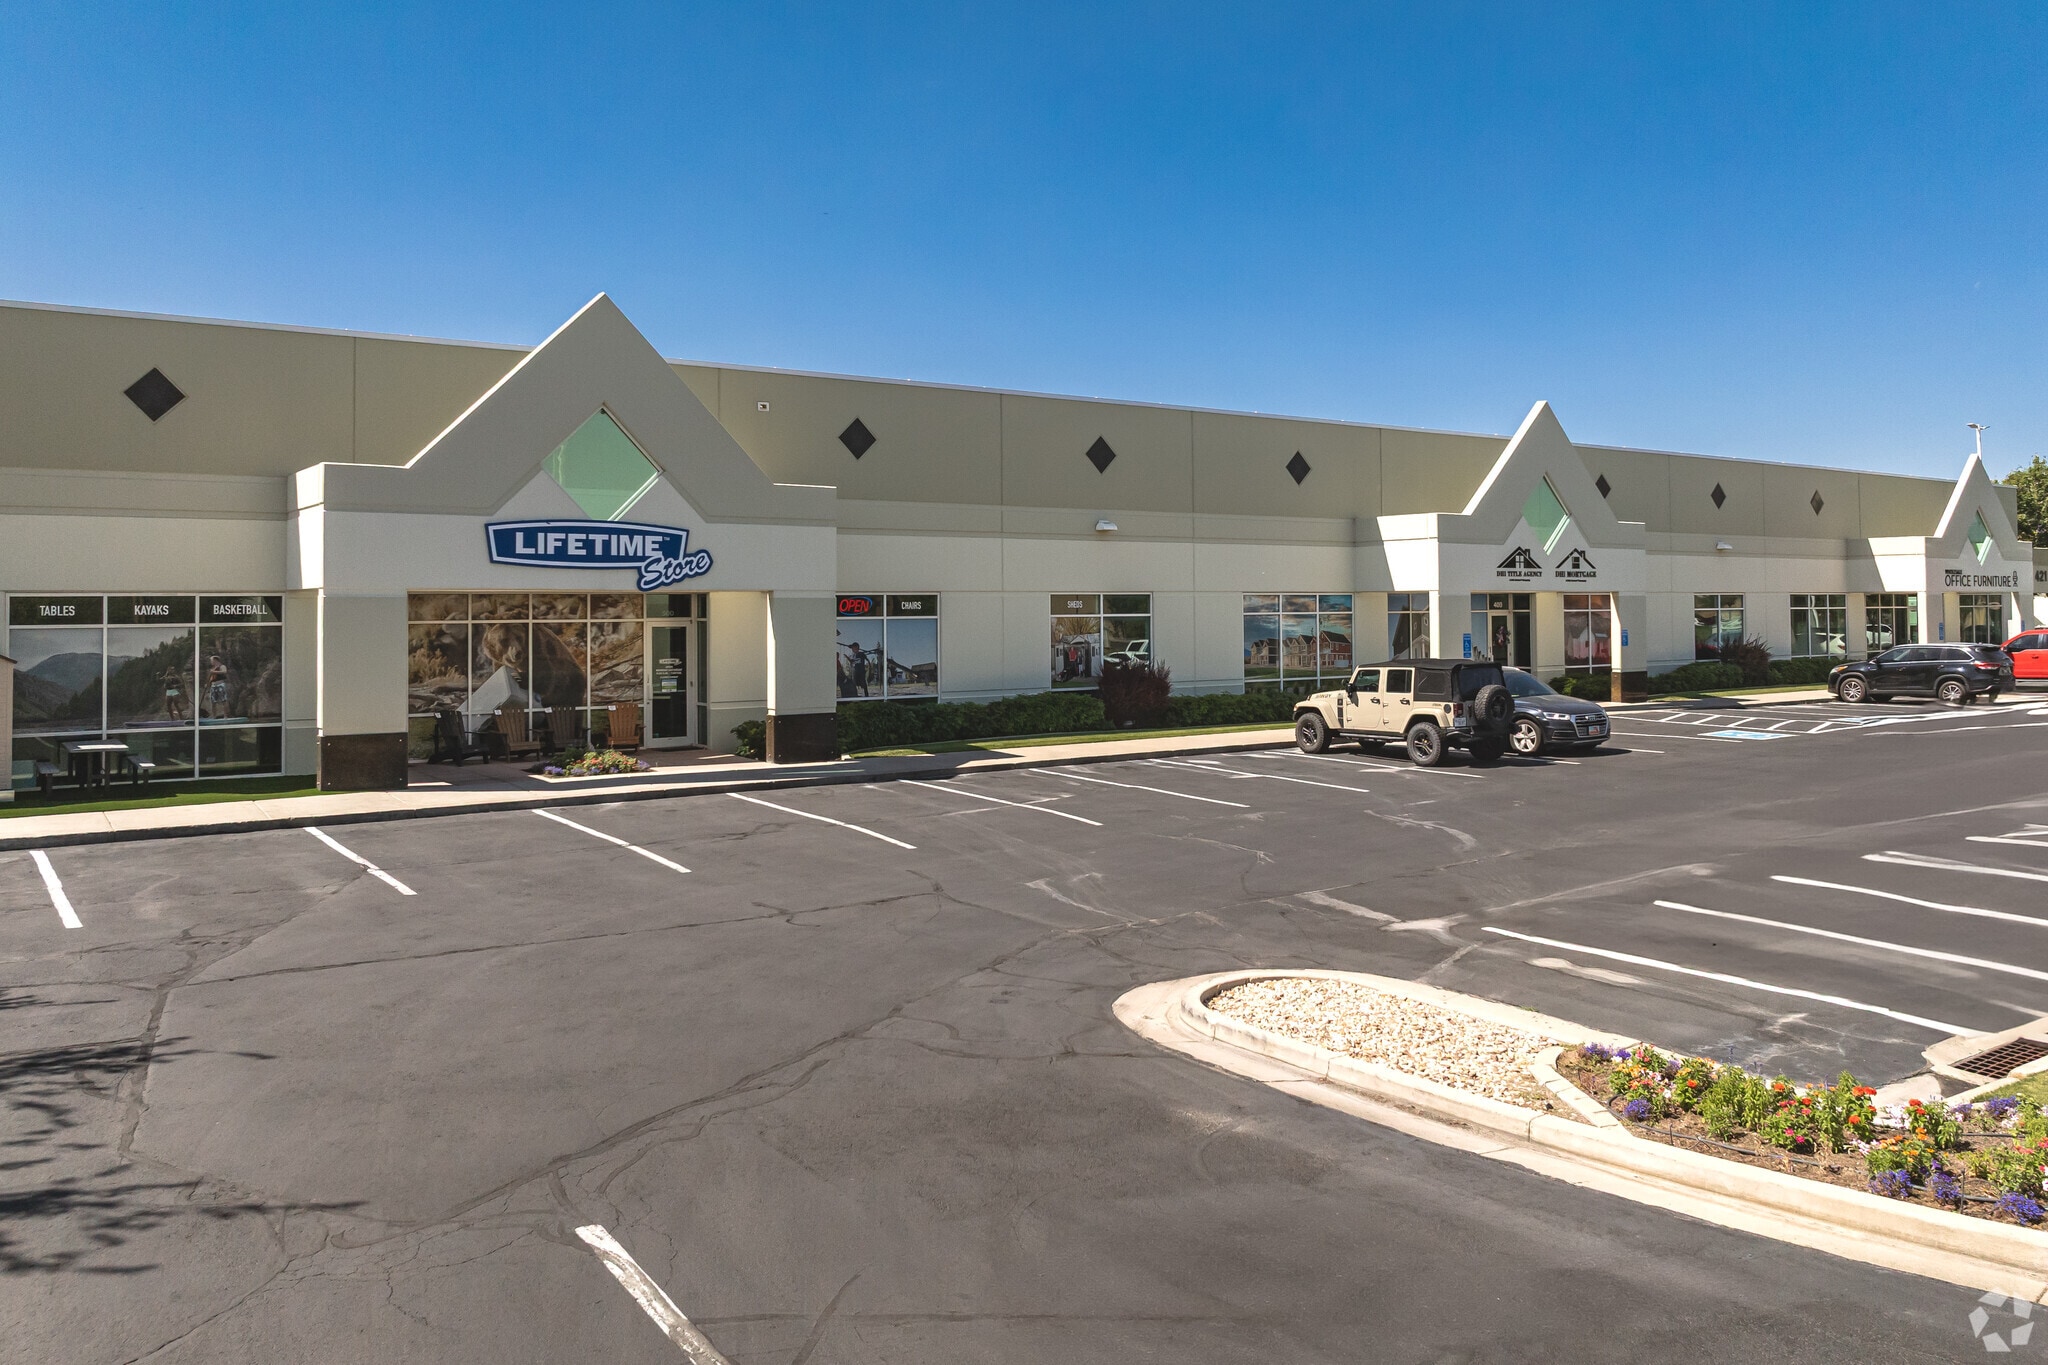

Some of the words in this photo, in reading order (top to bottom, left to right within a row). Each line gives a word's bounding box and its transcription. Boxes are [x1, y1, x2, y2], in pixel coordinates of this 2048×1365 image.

[515, 532, 662, 557] LIFETIME
[642, 552, 710, 586] Store
[1945, 575, 1971, 587] OFFICE
[1974, 575, 2011, 587] FURNITURE
[2035, 570, 2047, 582] 421
[213, 604, 268, 615] BASKETBALL
[839, 599, 870, 612] OPEN
[1068, 600, 1082, 608] SHEDS
[40, 605, 76, 616] TABLES
[134, 605, 169, 616] KAYAKS
